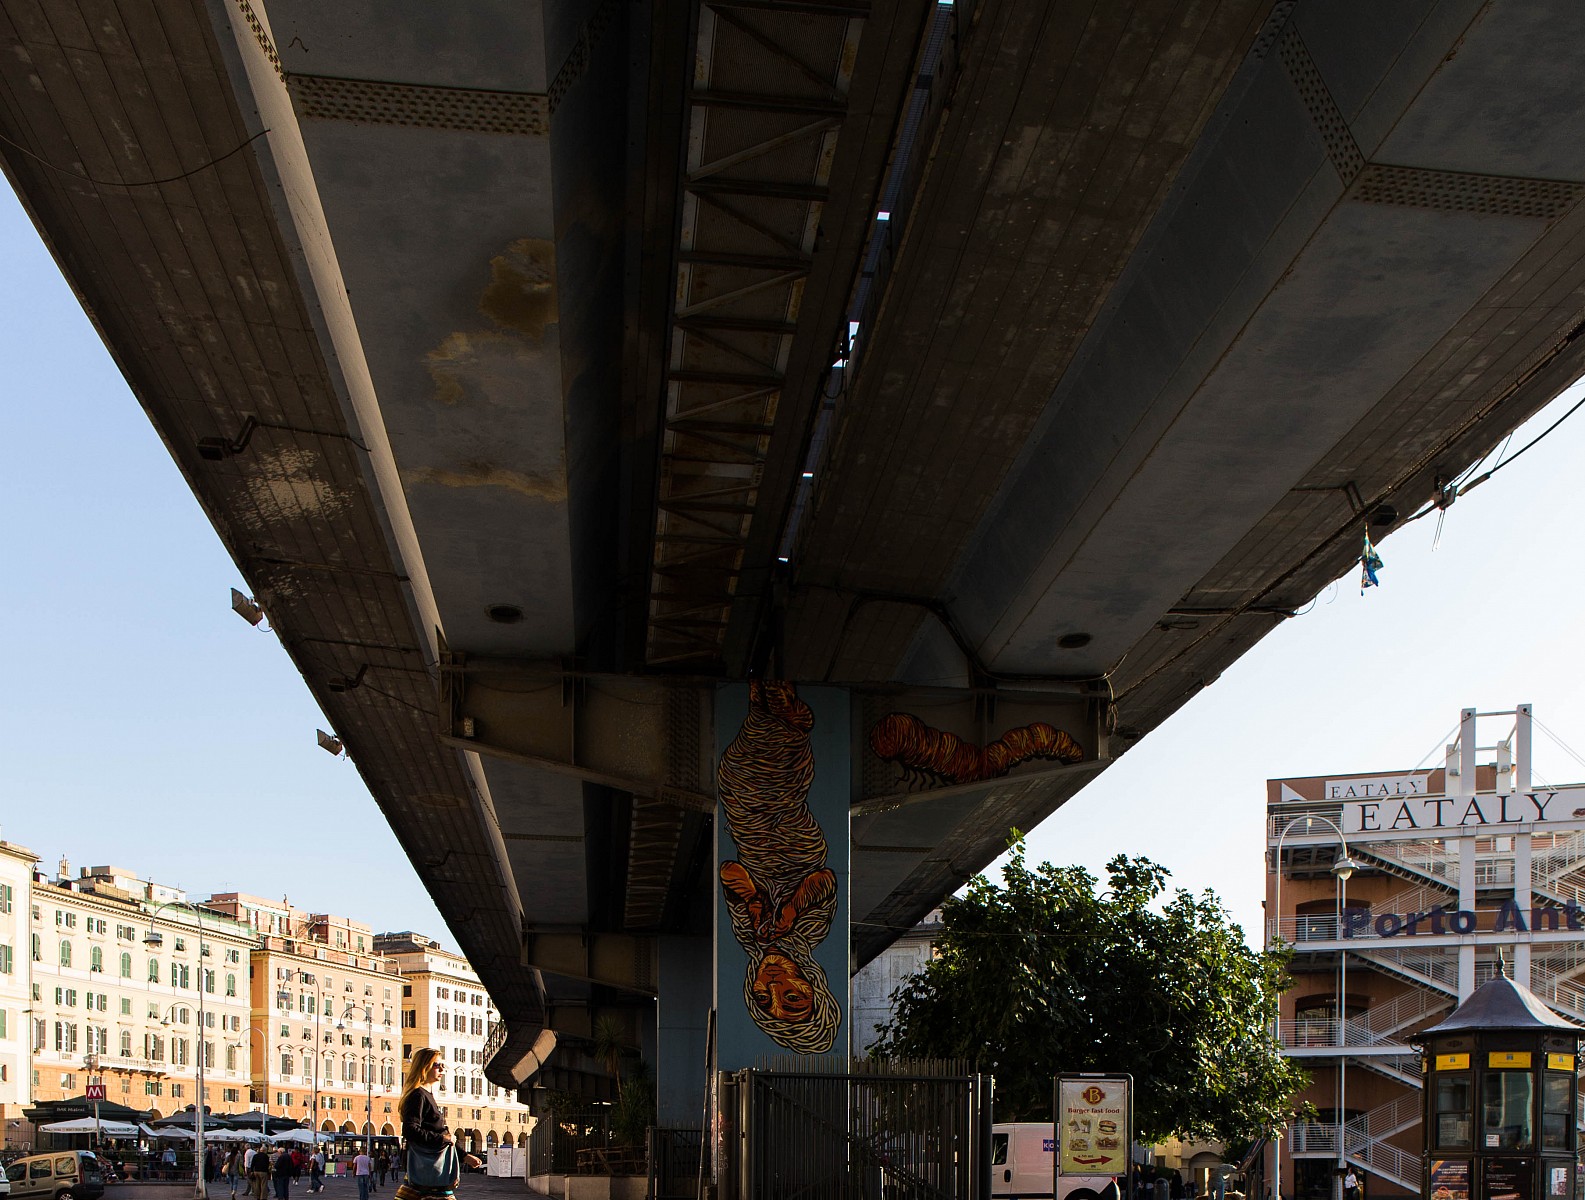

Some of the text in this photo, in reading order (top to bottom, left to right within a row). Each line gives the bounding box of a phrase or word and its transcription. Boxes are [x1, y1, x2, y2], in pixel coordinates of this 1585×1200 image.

[1330, 781, 1422, 798] EATALY
[1357, 792, 1559, 832] EATALY
[1343, 904, 1477, 938] Porto
[87, 1086, 102, 1097] M
[1089, 1088, 1101, 1102] B
[1067, 1107, 1089, 1115] Burger
